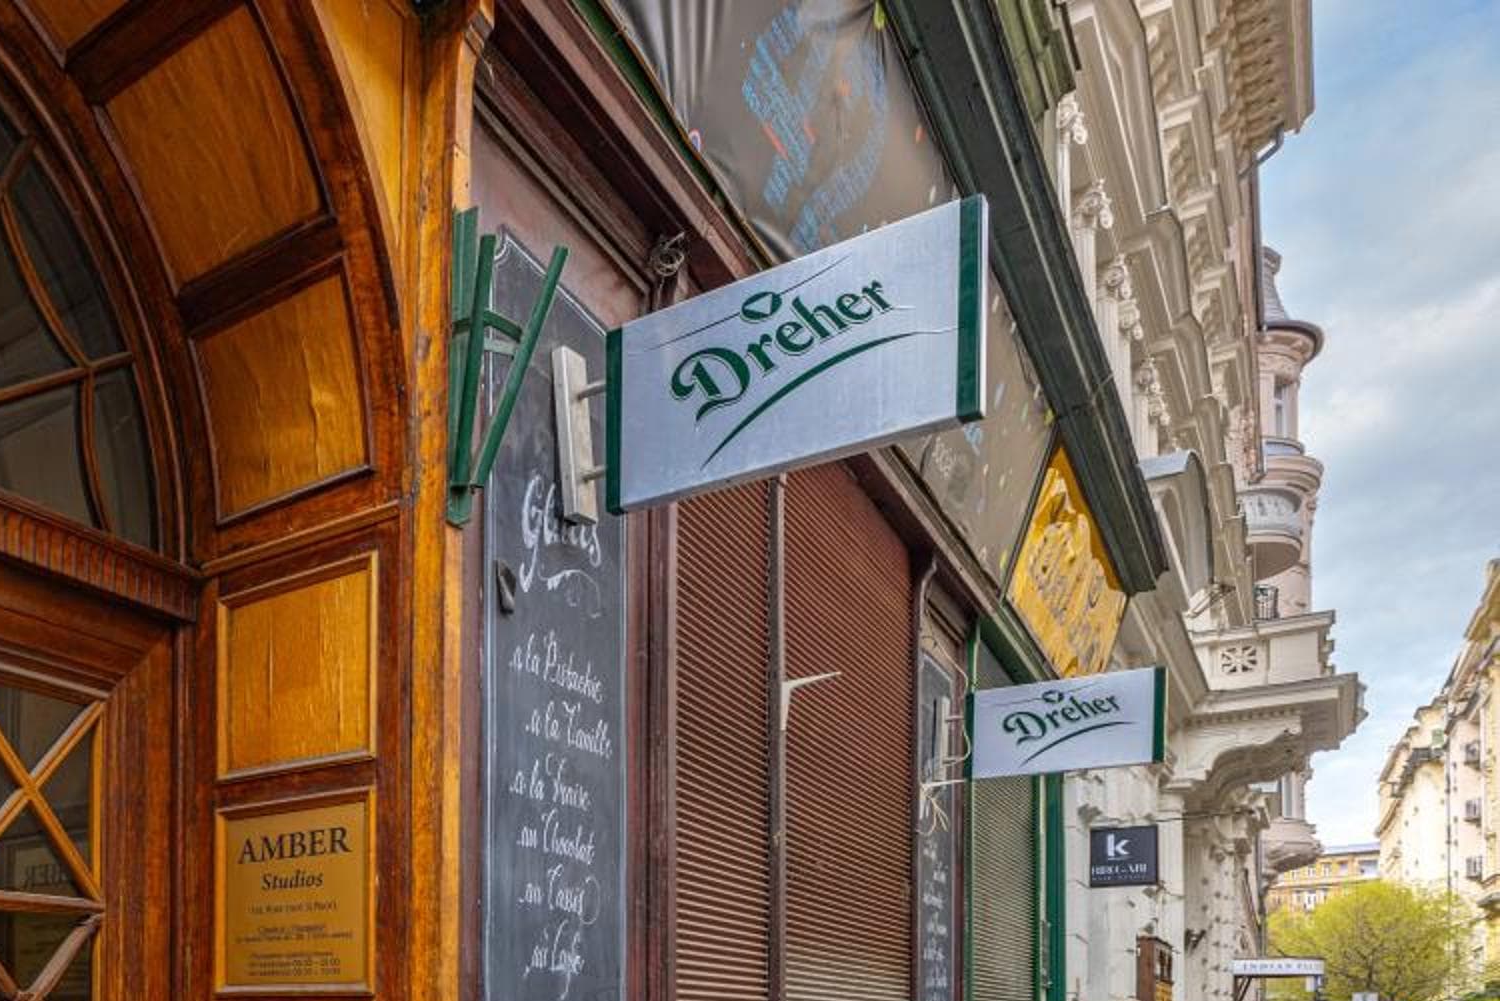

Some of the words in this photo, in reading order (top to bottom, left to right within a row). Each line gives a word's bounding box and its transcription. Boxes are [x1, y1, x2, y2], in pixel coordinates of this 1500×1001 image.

[670, 278, 894, 423] Dreher
[1002, 694, 1121, 745] Dreher
[237, 826, 352, 865] AMBER
[261, 869, 324, 891] Studios
